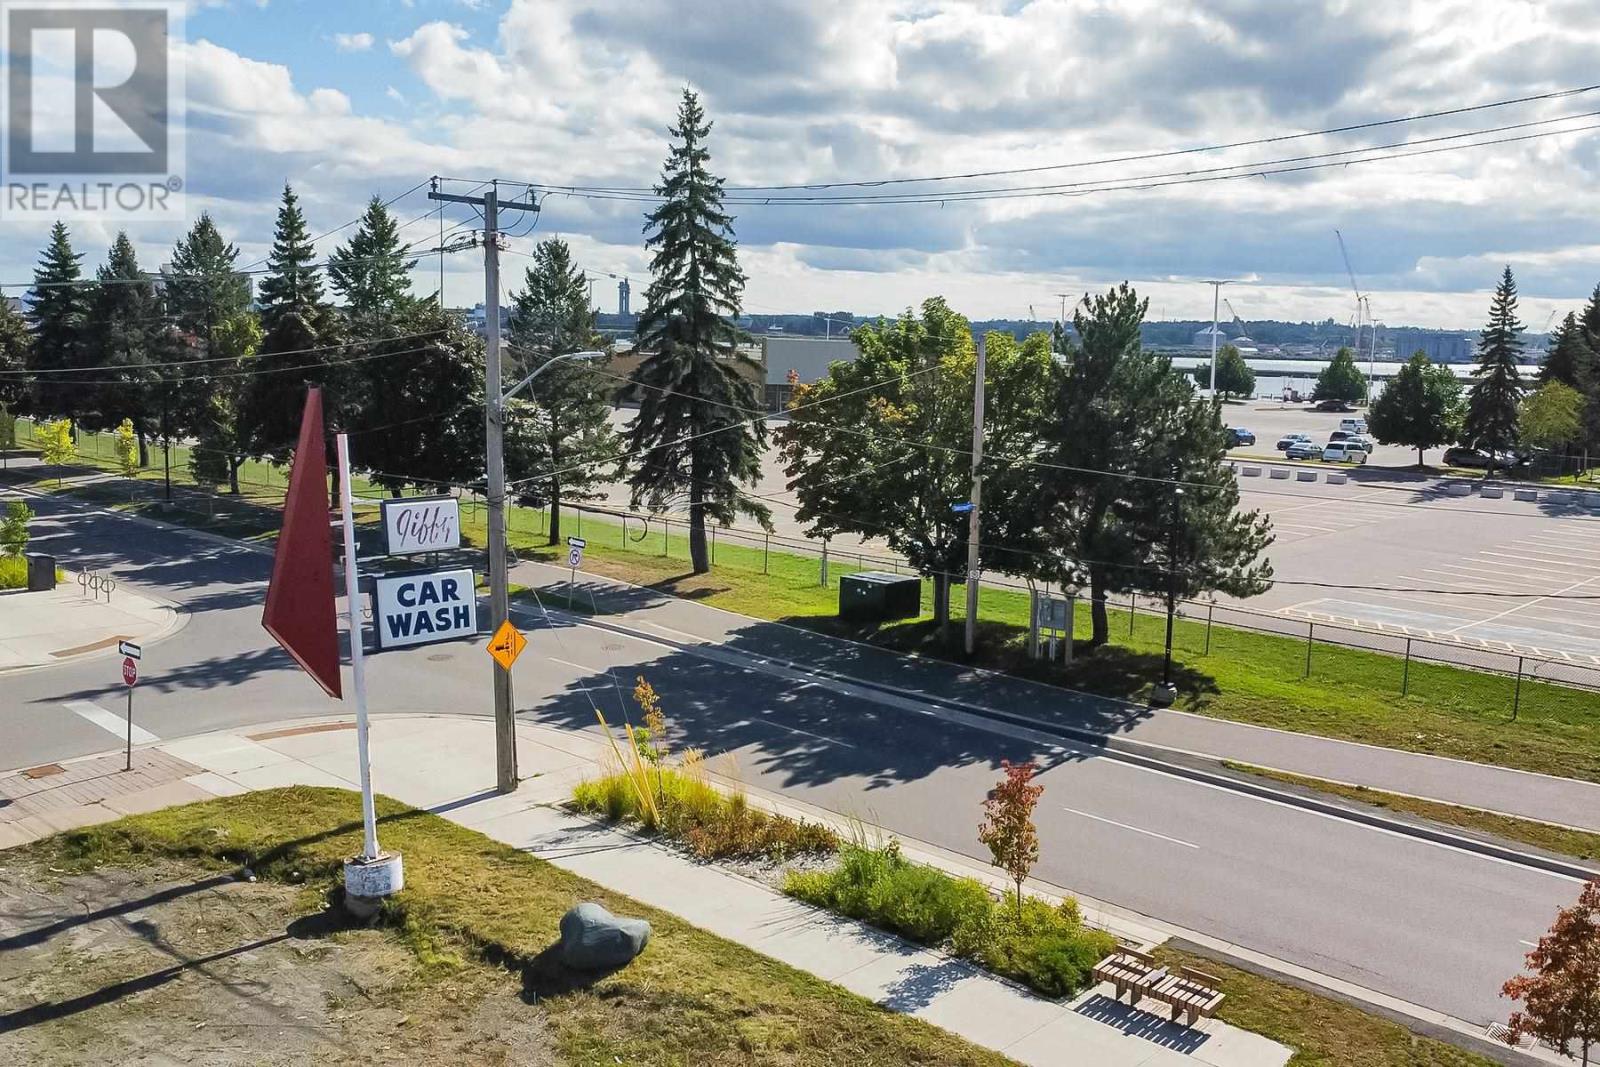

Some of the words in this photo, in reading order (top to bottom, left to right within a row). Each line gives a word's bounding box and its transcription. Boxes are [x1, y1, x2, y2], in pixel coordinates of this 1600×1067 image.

[397, 578, 461, 608] CAR
[386, 604, 471, 638] WASH
[123, 664, 137, 678] STOP
